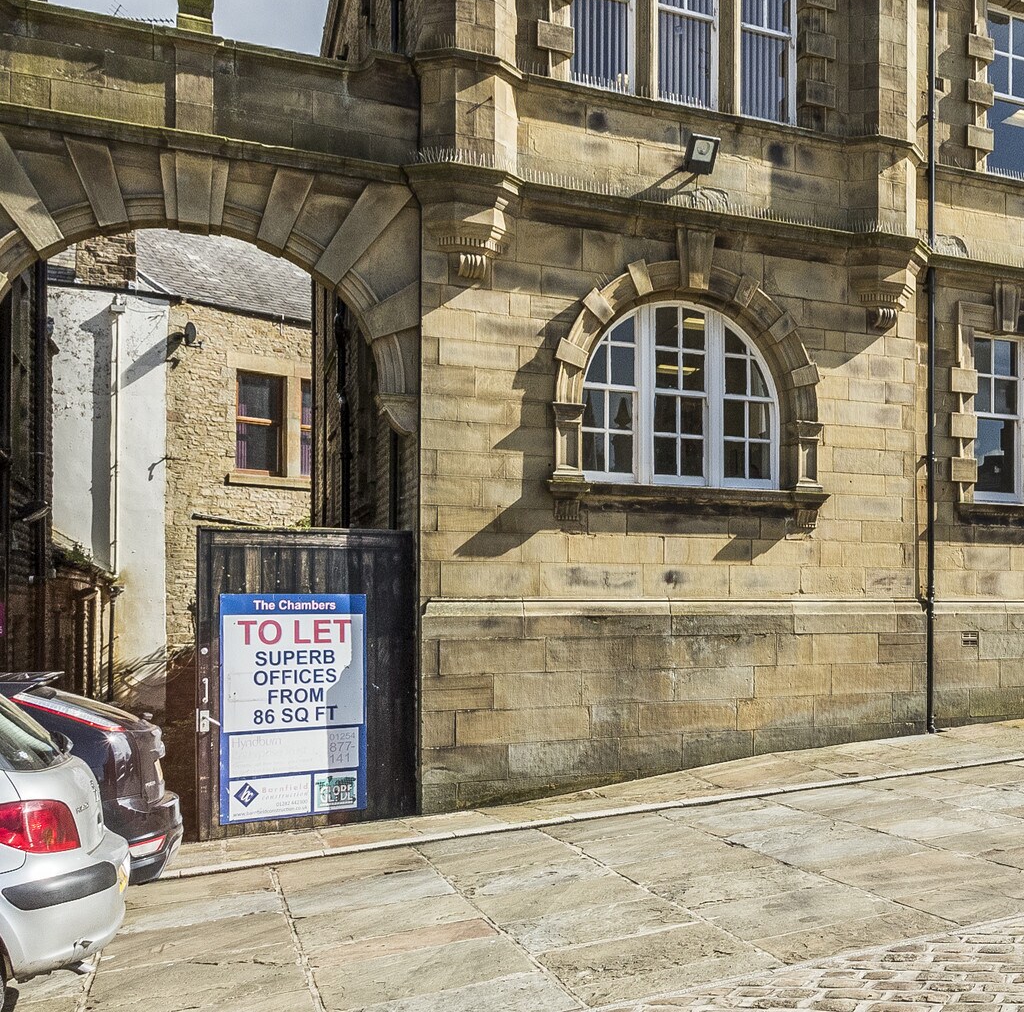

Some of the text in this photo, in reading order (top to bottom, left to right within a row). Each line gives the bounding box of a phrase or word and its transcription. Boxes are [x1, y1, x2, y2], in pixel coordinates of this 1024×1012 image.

[253, 599, 336, 610] The Chambers
[237, 619, 352, 645] TO LET
[255, 649, 335, 666] SUPERB
[253, 668, 337, 686] OFFICES
[268, 687, 324, 705] FROM
[253, 705, 338, 725] 86 SQ FT
[231, 736, 282, 749] Hyndburn
[329, 732, 355, 741] 01254
[329, 753, 351, 764] 141
